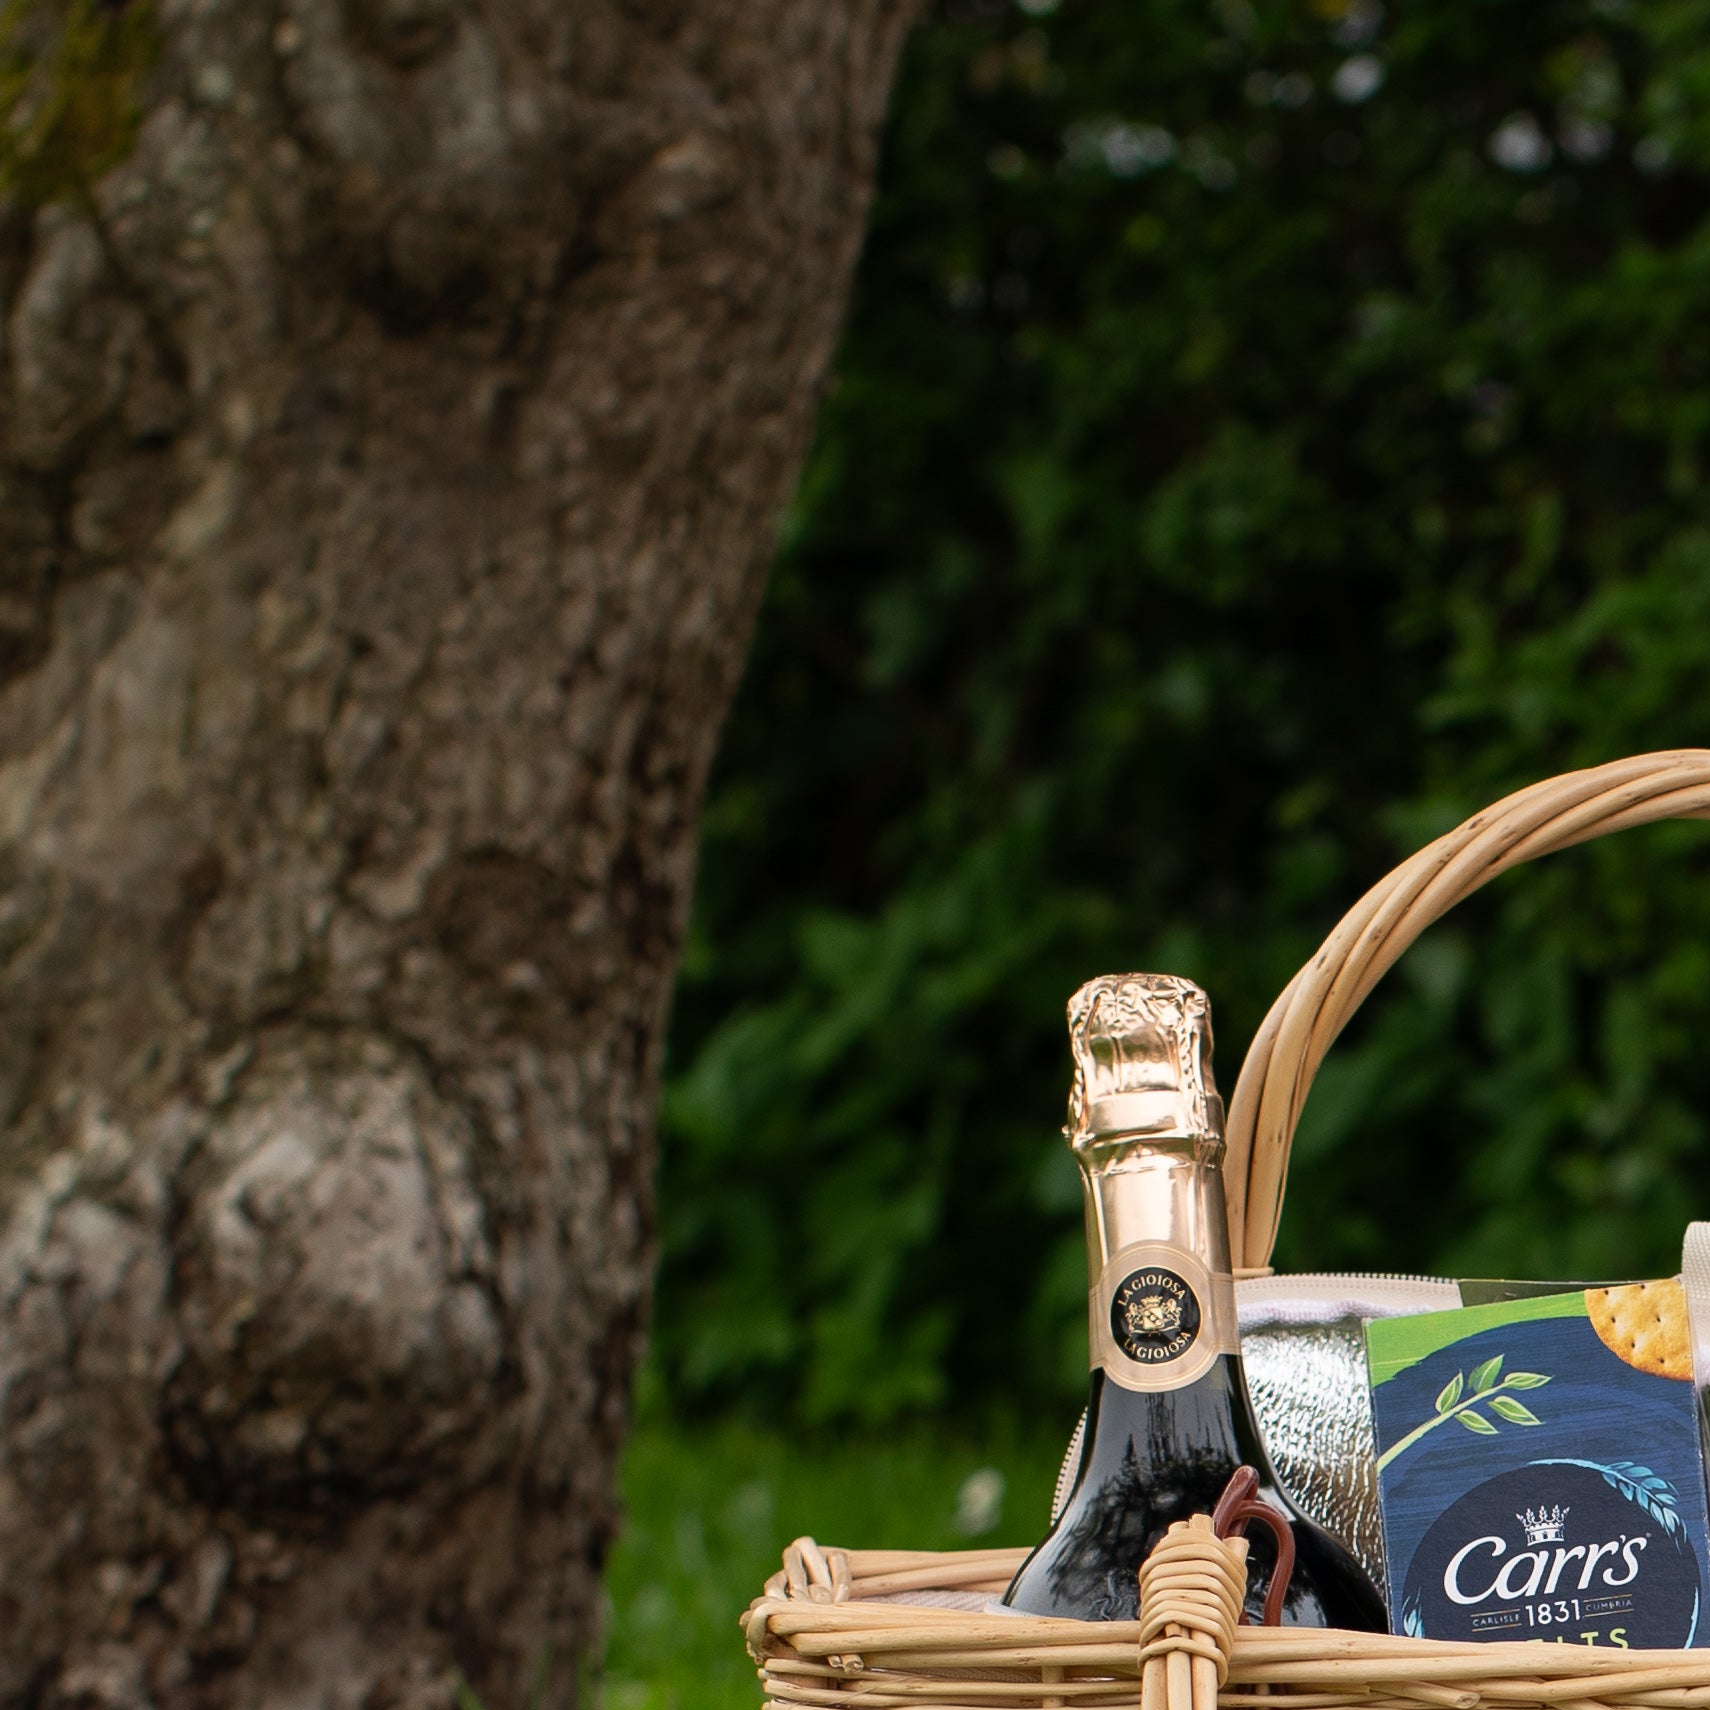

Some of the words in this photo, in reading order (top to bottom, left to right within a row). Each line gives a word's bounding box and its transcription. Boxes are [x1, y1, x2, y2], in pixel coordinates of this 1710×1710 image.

[1118, 1289, 1133, 1306] LA
[1131, 1274, 1186, 1300] GIOIOSA
[1136, 1332, 1191, 1359] GIOIOSA
[1443, 1535, 1648, 1605] Carr's
[1472, 1613, 1521, 1627] CARLISLE
[1525, 1599, 1582, 1627] 1831
[1585, 1599, 1633, 1612] CUMBRIA
